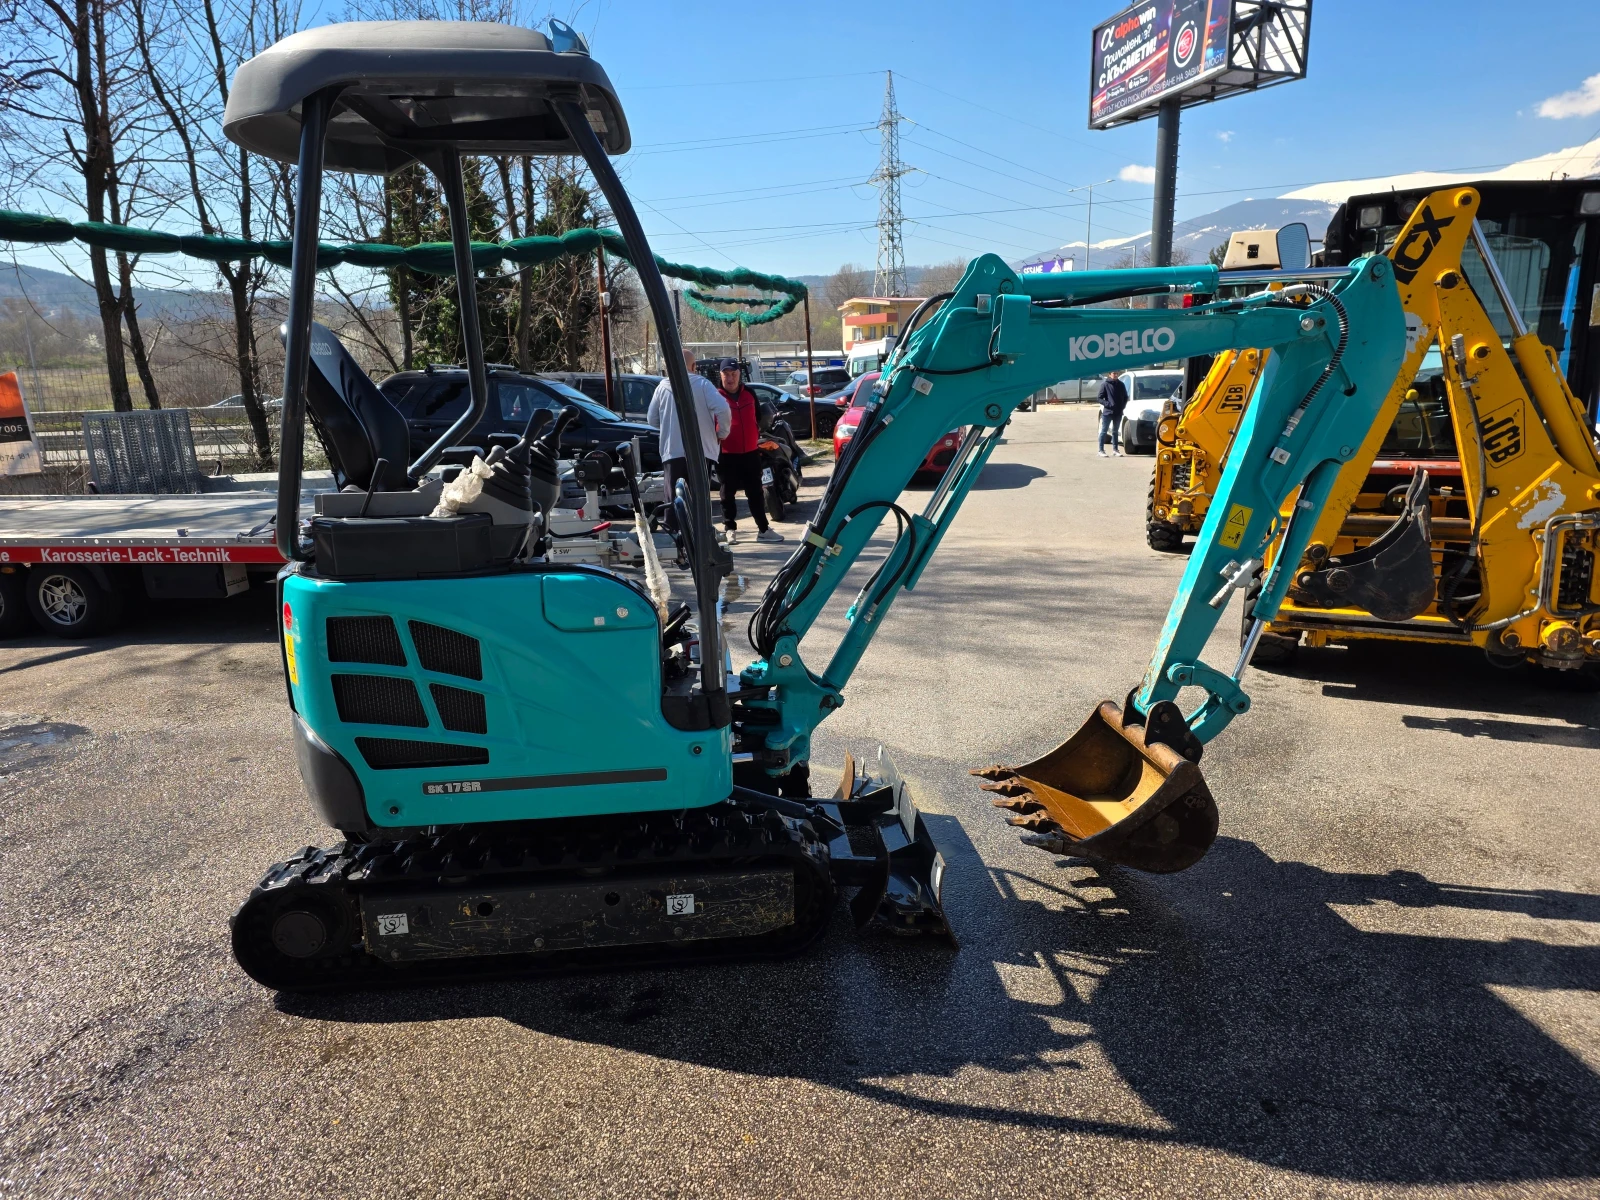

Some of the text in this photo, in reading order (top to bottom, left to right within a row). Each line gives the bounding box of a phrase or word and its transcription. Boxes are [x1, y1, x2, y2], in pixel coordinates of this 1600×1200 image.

[1115, 7, 1156, 39] alphawin
[1069, 327, 1175, 362] KOBELCO
[1220, 386, 1244, 411] JCB
[1478, 416, 1520, 463] JCB
